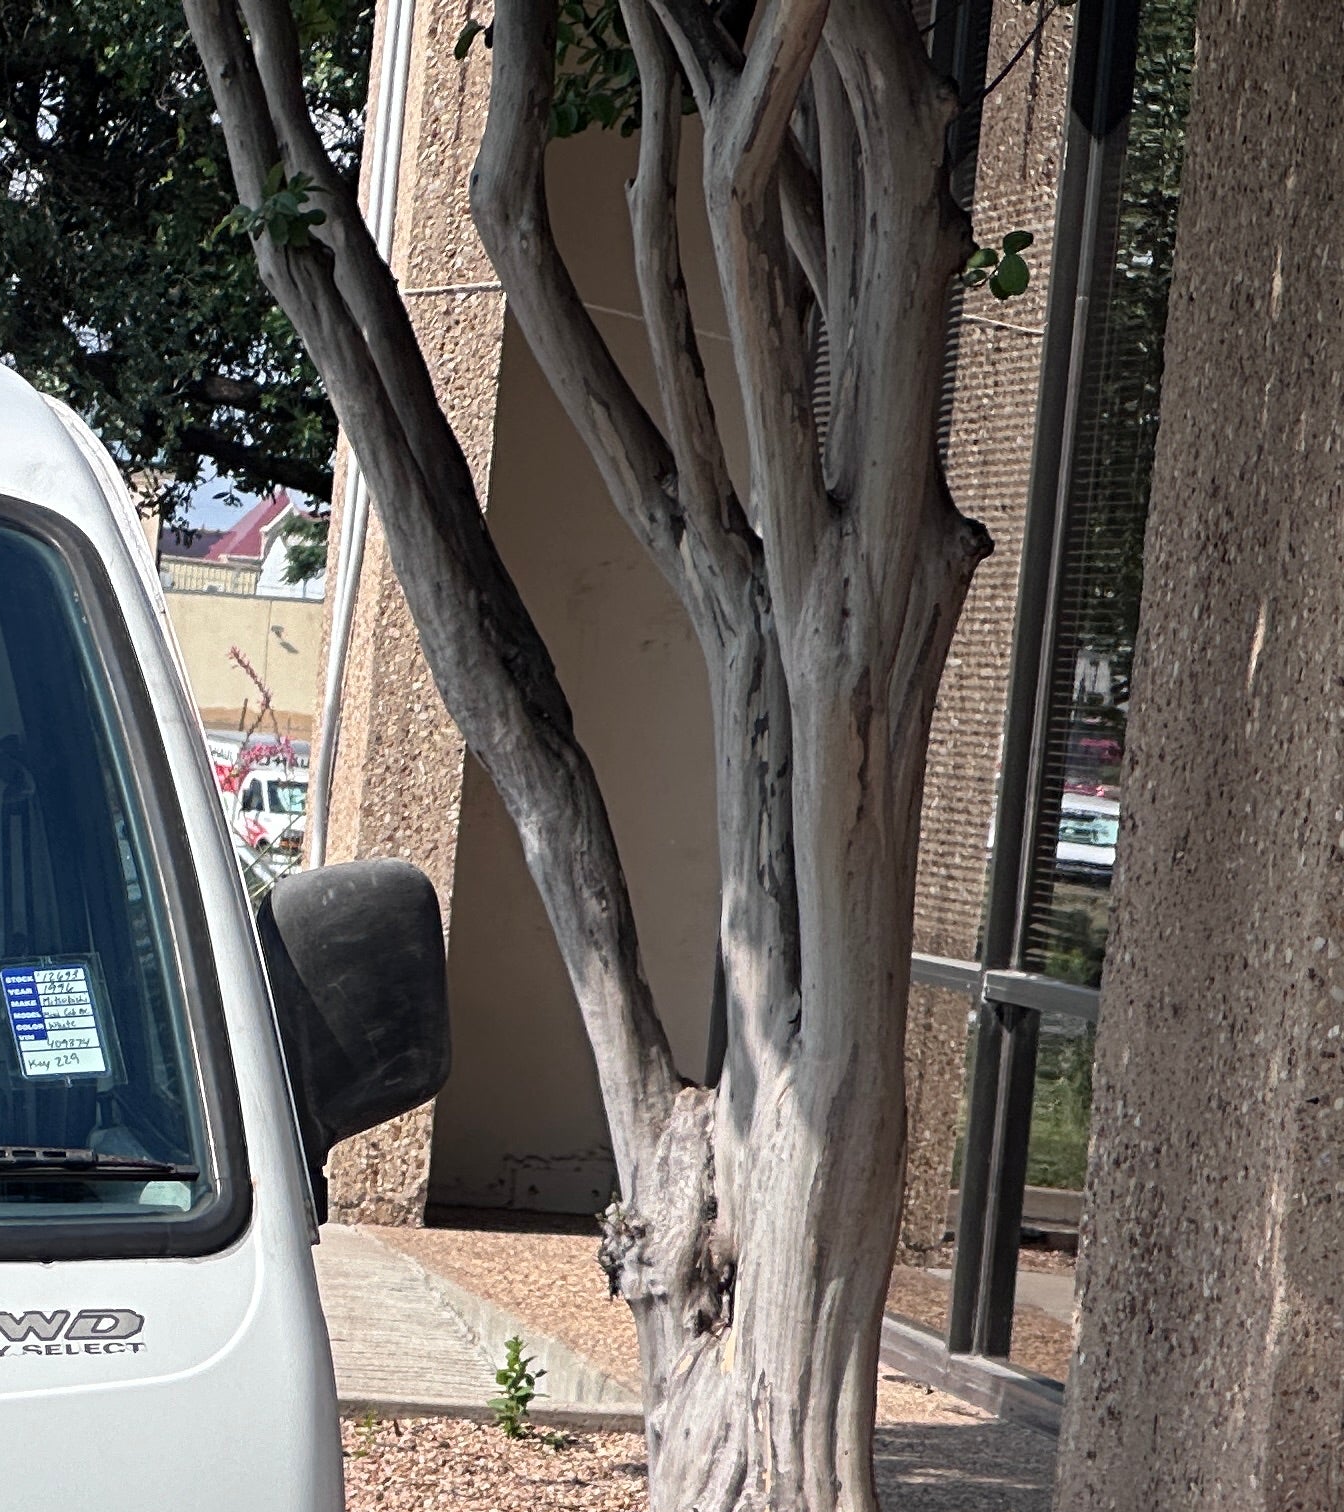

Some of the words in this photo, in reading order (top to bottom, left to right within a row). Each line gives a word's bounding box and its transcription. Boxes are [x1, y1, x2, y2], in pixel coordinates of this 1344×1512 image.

[5, 975, 34, 984] STOCK
[7, 987, 33, 996] YEAR
[43, 983, 75, 995] 1996
[10, 999, 38, 1008] MAKE
[15, 1023, 45, 1032] COLOR
[54, 1052, 80, 1067] 229
[22, 1342, 146, 1356] SELECT
